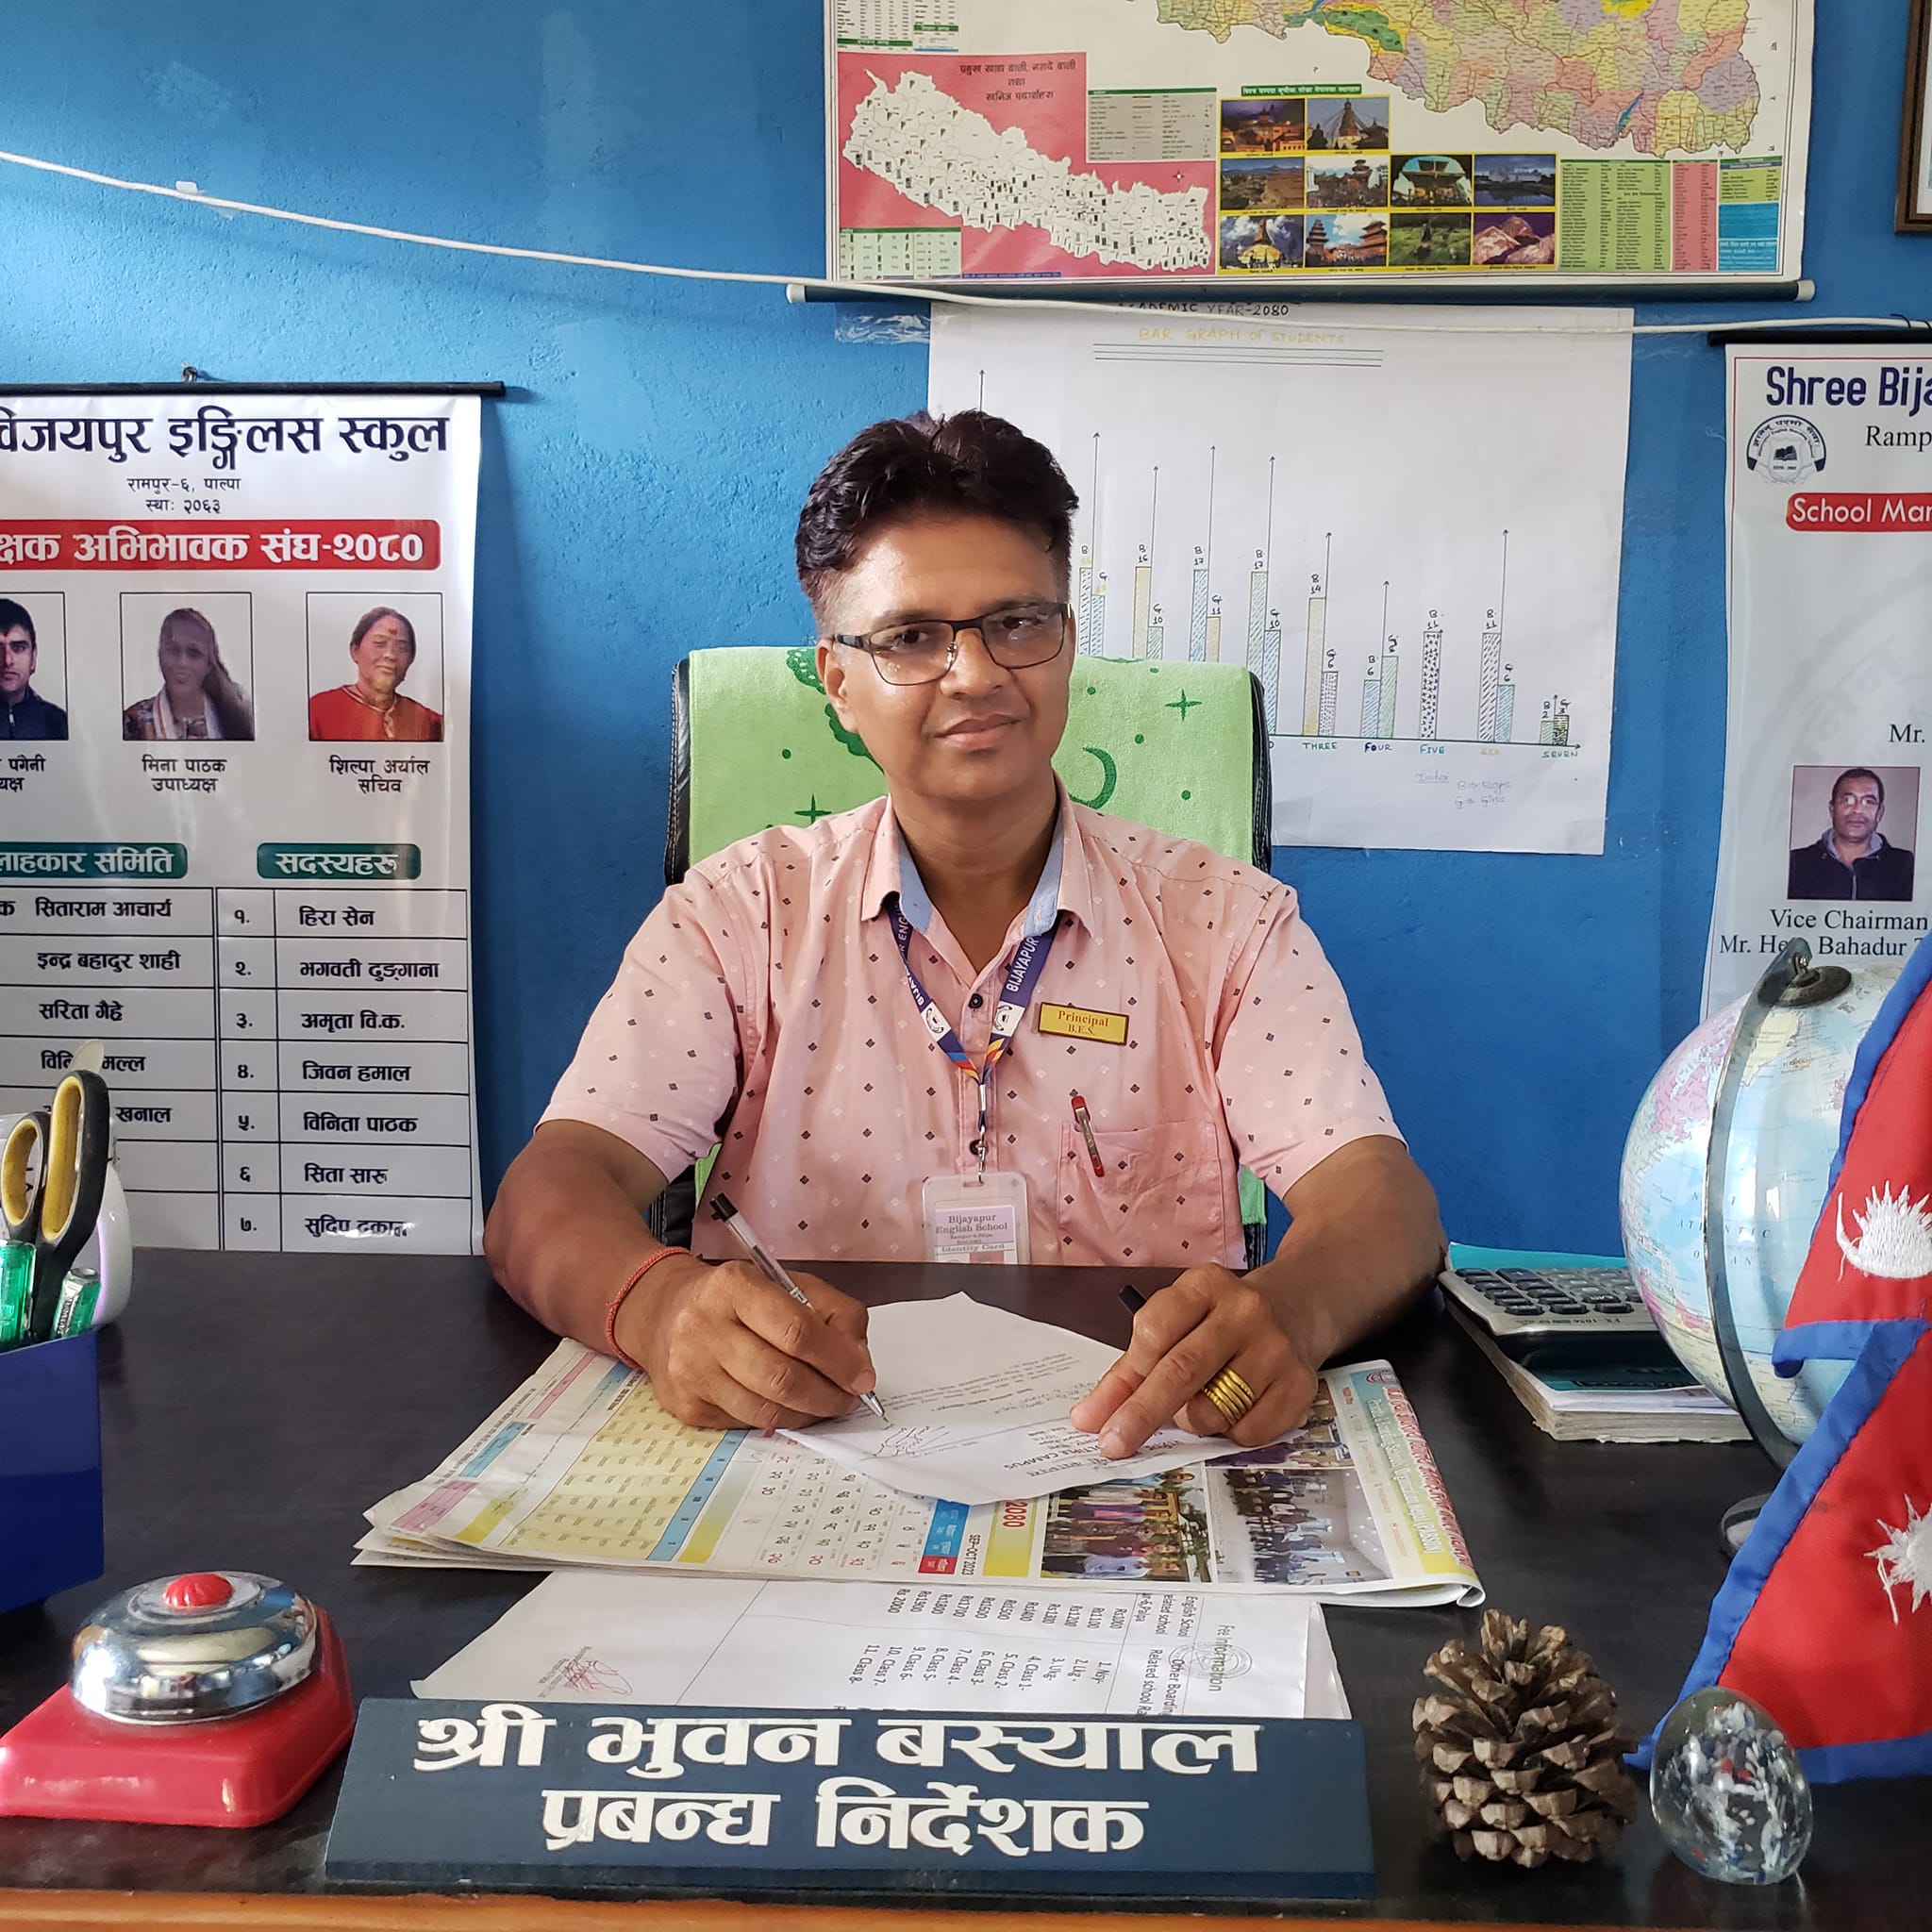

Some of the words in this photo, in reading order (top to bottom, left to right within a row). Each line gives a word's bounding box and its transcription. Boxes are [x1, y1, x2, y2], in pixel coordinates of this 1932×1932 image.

[1139, 328, 1171, 341] BAR
[1186, 327, 1241, 342] GRAPH
[1272, 331, 1345, 343] STUDENTS
[1767, 366, 1867, 406] Shree
[338, 417, 450, 461] स्कुल
[204, 478, 242, 491] पाल्पा
[183, 498, 221, 514] २०६३
[1791, 497, 1873, 523] School
[73, 525, 251, 561] अभिभावक
[260, 527, 424, 564] संघ-२०८०
[1153, 616, 1163, 625] 10
[1270, 619, 1280, 629] 10
[1890, 724, 1925, 744] Mr.
[1302, 741, 1338, 751] THREE
[1364, 741, 1392, 753] FOUR
[1420, 743, 1445, 755] FIVE
[142, 754, 177, 772] मिना
[185, 758, 226, 773] पाठक
[329, 755, 375, 774] शिल्पा
[384, 756, 430, 774] अर्याल
[151, 777, 219, 793] उपाध्यक्ष
[358, 774, 403, 793] सचिव
[94, 846, 175, 874] समिति
[35, 897, 108, 917] सिताराम
[113, 899, 173, 917] आचार्य
[235, 909, 251, 924] १.
[299, 906, 337, 926] हिरा
[342, 907, 376, 926] सेन
[1770, 908, 1817, 928] Vice
[1824, 910, 1928, 931] Chairman
[1720, 935, 1751, 954] Mr.
[1818, 936, 1907, 957] Bahadur
[38, 953, 72, 970] इन्द्र
[77, 953, 134, 973] बहादुर
[139, 950, 181, 970] शाही
[235, 962, 252, 976] २.
[300, 958, 362, 978] भगवती
[1006, 936, 1040, 992] BIJAYAPUR
[39, 999, 91, 1020] सरिता
[1058, 1010, 1109, 1026] Principal
[236, 1013, 253, 1027] ३.
[301, 1013, 355, 1033] अमृता
[360, 1009, 406, 1029] वि.क.
[1068, 1024, 1094, 1036] B.E.S.
[237, 1064, 255, 1078] ४.
[302, 1060, 353, 1080] जिवन
[358, 1066, 412, 1082] हमाल
[115, 1107, 173, 1123] खनाल
[238, 1115, 256, 1130] ५.
[303, 1111, 361, 1132] विनिता
[366, 1117, 420, 1133] पाठक
[240, 1166, 252, 1182] ६
[304, 1162, 345, 1183] सिता
[241, 1217, 258, 1231] ७.
[936, 1224, 973, 1235] English
[975, 1223, 1008, 1232] School
[948, 1214, 996, 1224] Bijayapur
[941, 1244, 979, 1253] Identity
[1002, 1501, 1029, 1527] 2080
[965, 1534, 981, 1560] SEP-OCT
[960, 1559, 976, 1575] 2023
[887, 1597, 908, 1614] 2000
[931, 1593, 953, 1615] Rs1800
[953, 1595, 974, 1618] Rs1700
[974, 1596, 996, 1619] Rs1600
[997, 1599, 1017, 1621] Rs1500
[1020, 1601, 1040, 1622] Rs1400
[1041, 1603, 1061, 1624] Rs1300
[1181, 1595, 1198, 1618] English
[1063, 1606, 1083, 1627] Rs1200
[1087, 1607, 1106, 1629] Rs1100
[1109, 1607, 1128, 1629] Rs1000
[1155, 1614, 1172, 1635] school
[1177, 1618, 1194, 1638] School
[1217, 1624, 1236, 1637] Fee
[864, 1644, 880, 1655] 11.
[887, 1646, 903, 1656] 10.
[852, 1657, 873, 1675] Class
[875, 1658, 896, 1680] Class
[903, 1654, 923, 1672] Class
[925, 1654, 945, 1673] Class
[950, 1656, 969, 1674] Class
[973, 1658, 992, 1677] Class
[996, 1660, 1016, 1680] Class
[1021, 1663, 1040, 1683] Class
[1145, 1649, 1163, 1679] Related
[1170, 1658, 1185, 1682] Other
[1208, 1637, 1234, 1691] Information
[1139, 1680, 1158, 1705] school
[413, 1702, 558, 1771] श्री
[586, 1716, 852, 1779] भुवन
[876, 1718, 1262, 1775] बस्याल
[541, 1789, 782, 1851] प्रबन्ध
[814, 1775, 1150, 1857] निर्देशक
